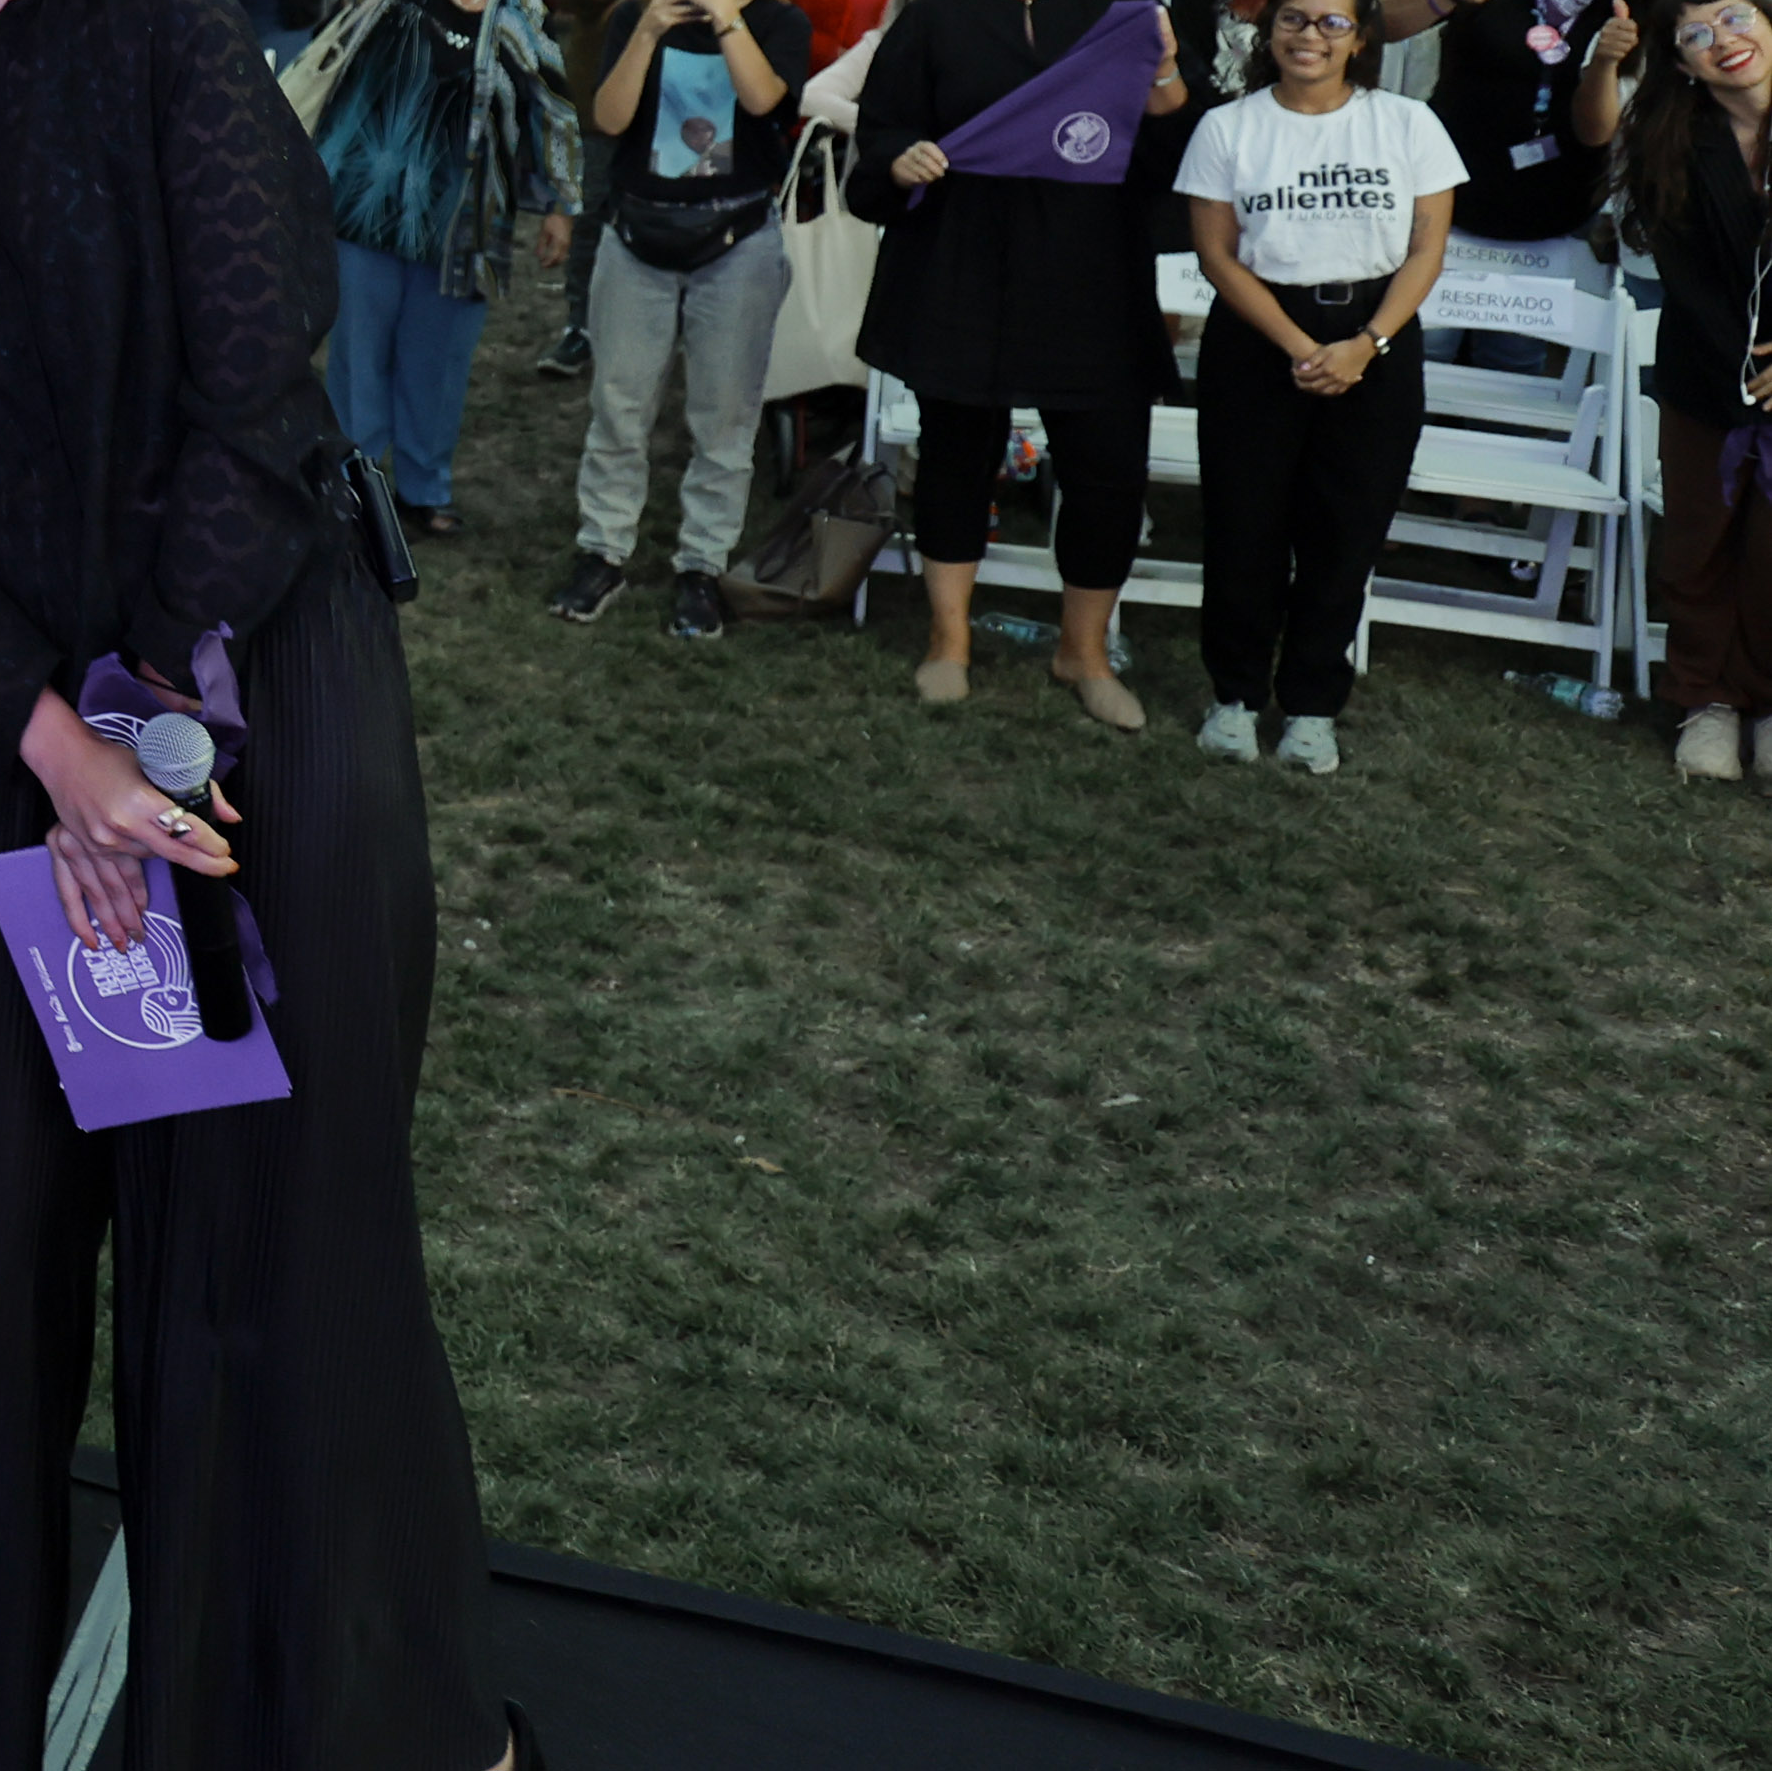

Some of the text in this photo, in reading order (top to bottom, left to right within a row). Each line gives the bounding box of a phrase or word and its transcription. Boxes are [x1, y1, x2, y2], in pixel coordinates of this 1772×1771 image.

[1298, 161, 1391, 188] niñas
[1240, 184, 1396, 214] valientes
[1441, 289, 1554, 312] RESERVADO
[1437, 307, 1510, 324] CAROLINA
